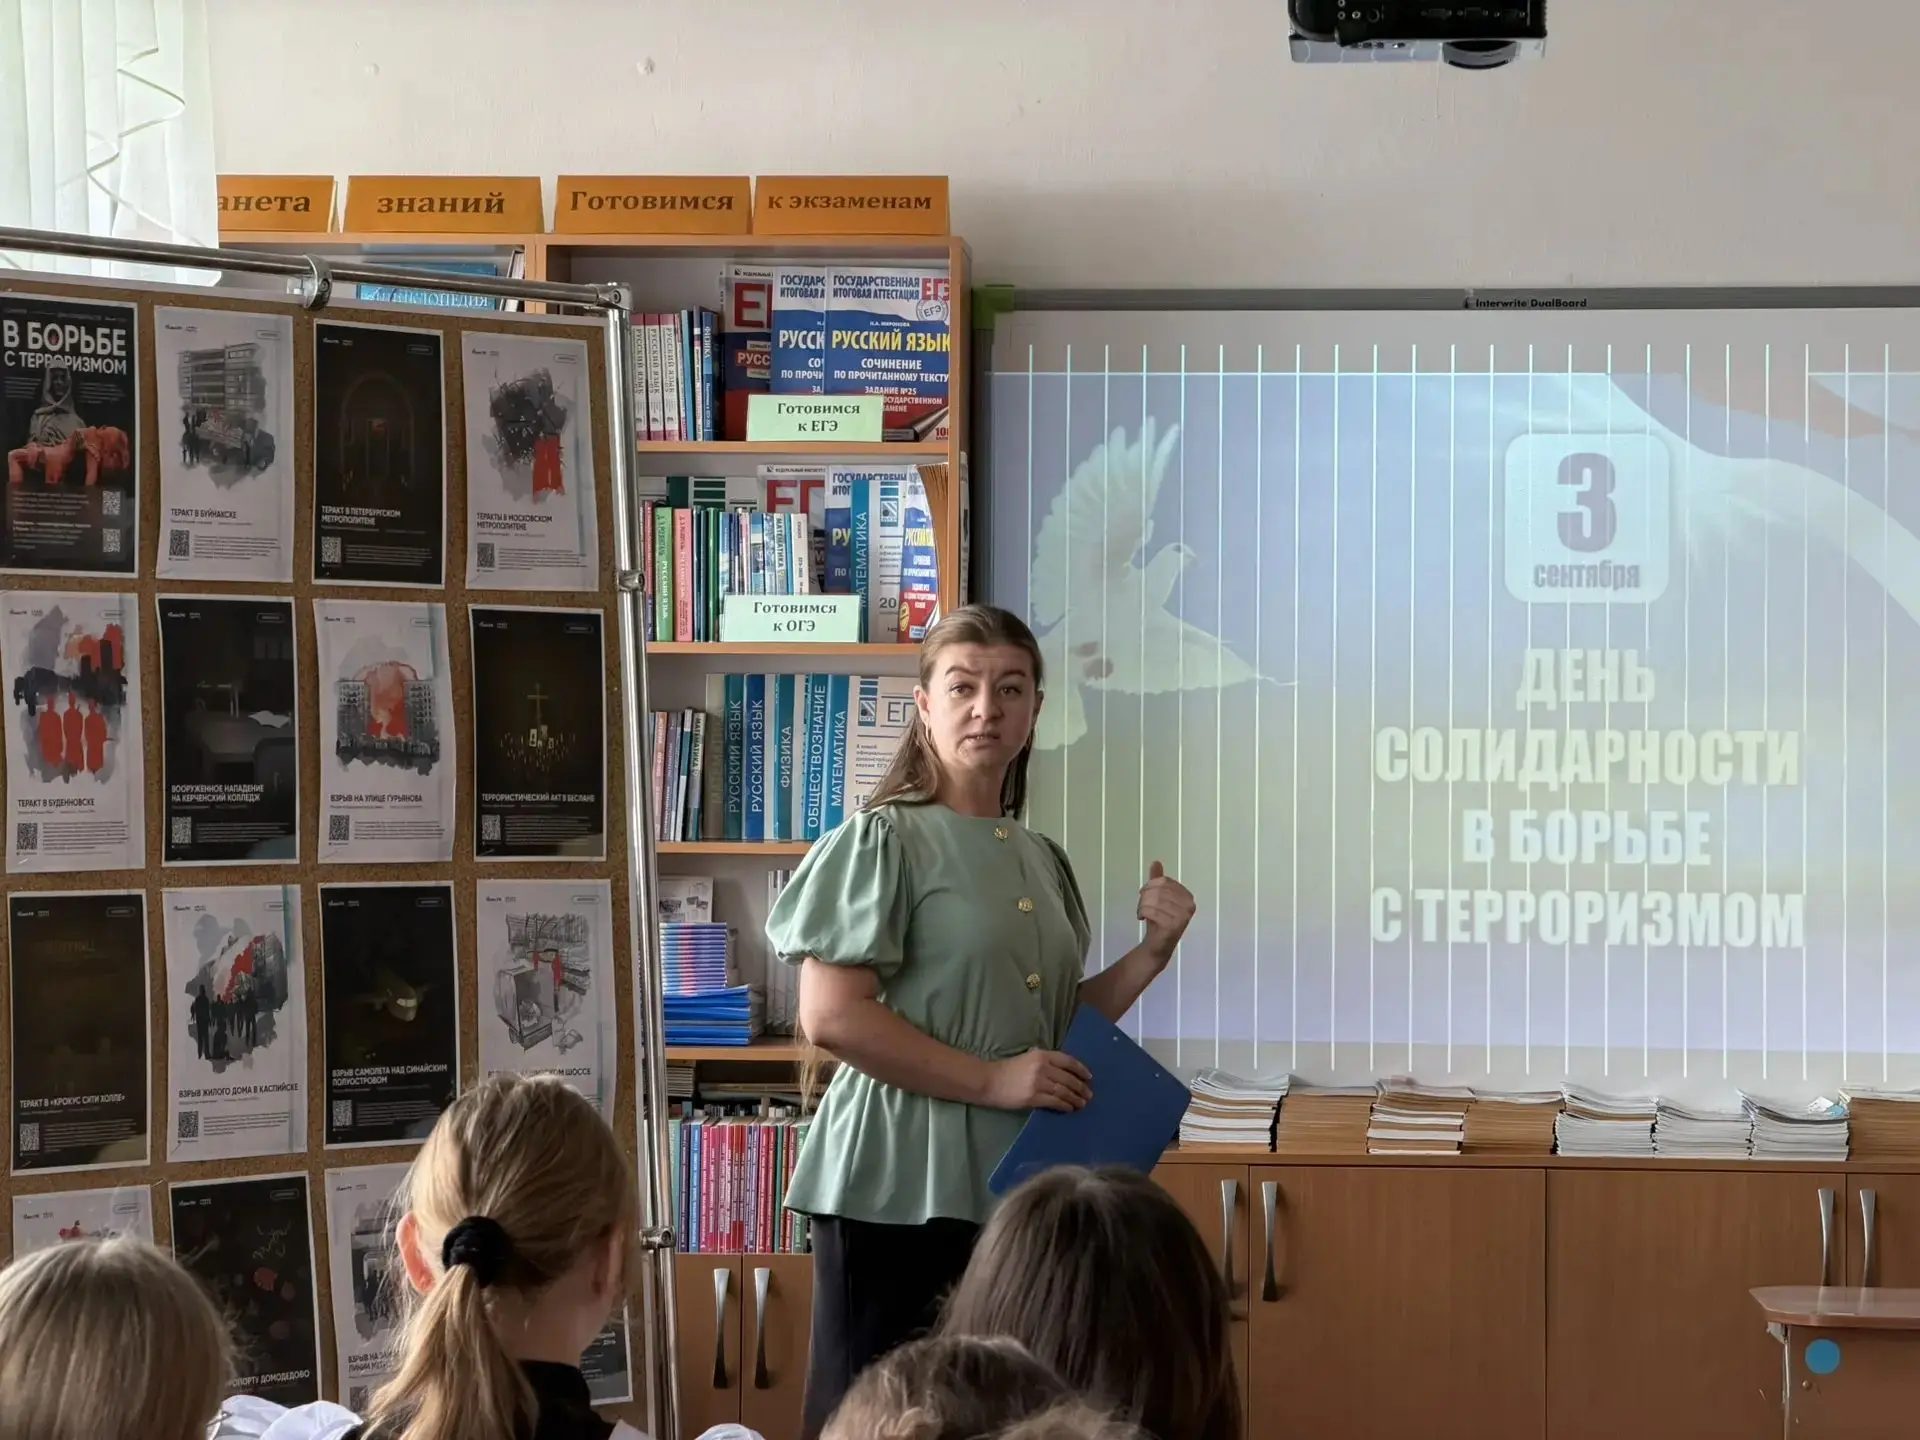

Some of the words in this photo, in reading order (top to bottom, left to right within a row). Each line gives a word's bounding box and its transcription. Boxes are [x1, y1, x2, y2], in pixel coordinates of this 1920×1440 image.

[377, 192, 505, 214] знаний
[570, 190, 733, 211] Готовимся
[768, 196, 783, 209] к
[789, 195, 932, 211] экзаменам
[833, 275, 920, 288] ГОСУДАРСТВЕННАЯ
[780, 287, 819, 299] ИТОГОВАЯ
[833, 288, 872, 299] ИТОГОВАЯ
[872, 289, 920, 301] АТТЕСТАЦИЯ
[921, 278, 950, 301] ЕГЭ
[1476, 298, 1527, 308] Interwrite
[1531, 298, 1587, 308] DualBoard
[923, 305, 942, 317] ЕГЭ
[3, 320, 20, 348] В
[27, 322, 127, 357] БОРЬБЕ
[832, 328, 902, 351] РУССКИЙ
[905, 332, 950, 352] ЯЗЫК
[4, 351, 16, 367] С
[737, 353, 771, 366] РУСС
[861, 358, 922, 370] СОЧИНЕНИЕ
[781, 370, 793, 379] ПО
[834, 370, 846, 379] ПО
[848, 371, 918, 382] ПРОЧИТАННОМУ
[920, 373, 949, 383] ТЕКСТУ
[865, 386, 898, 395] ЗАДАНИЕ
[900, 387, 917, 395] №25
[777, 403, 860, 414] Готовимся
[798, 422, 807, 432] к
[811, 421, 838, 432] ЕГЭ
[1556, 452, 1617, 553] 3
[171, 508, 194, 517] ТЕРАКТ
[195, 509, 199, 517] В
[200, 508, 237, 519] БУЙНАКСКЕ
[321, 505, 344, 515] ТЕРАКТ
[351, 507, 401, 518] ПЕТЕРБУРГСКОМ
[477, 513, 503, 521] ТЕРАКТЫ
[508, 514, 553, 523] МОСКОВСКОМ
[477, 522, 527, 531] МЕТРОПОЛИТЕНЕ
[775, 518, 785, 568] МАТЕМАТИКА
[855, 511, 867, 607] МАТЕМАТИКА
[835, 568, 846, 577] ПО
[1533, 561, 1640, 591] сентября
[754, 602, 837, 614] Готовимся
[773, 621, 782, 632] к
[786, 620, 816, 632] ОГЭ
[1516, 649, 1654, 711] ДЕНЬ
[730, 700, 741, 740] ЯЗЫК
[751, 700, 763, 740] ЯЗЫК
[780, 726, 791, 788] ФИЗИКА
[807, 685, 826, 828] ОБЩЕСТВОЗНАНИЕ
[830, 710, 846, 807] МАТЕМАТИКА
[1375, 727, 1798, 791] СОЛИДАРНОСТИ
[729, 745, 741, 813] РУССКИЙ
[750, 744, 763, 813] РУССКИЙ
[171, 784, 223, 793] ВООРУЖЕННОЕ
[224, 784, 264, 793] НАПАДЕНИЕ
[18, 799, 41, 808] ТЕРАКТ
[48, 798, 95, 808] БУДЕННОВСКЕ
[171, 794, 181, 802] НА
[182, 793, 226, 802] КЕРЧЕНСКИЙ
[227, 794, 260, 803] КОЛЛЕДЖ
[365, 795, 385, 803] УЛИЦЕ
[387, 794, 423, 802] ГУРЬЯНОВА
[482, 793, 549, 801] ТЕРРОРИСТИЧЕСКИЙ
[1463, 810, 1495, 864] В
[1509, 810, 1711, 866] БОРЬБЕ
[1371, 888, 1402, 943] С
[1415, 889, 1805, 949] ТЕРРОРИЗМОМ
[332, 1069, 353, 1077] ВЗРЫВ
[355, 1067, 390, 1077] САМОЛЕТА
[391, 1066, 404, 1075] НАД
[406, 1063, 447, 1074] СИНАЙСКИМ
[565, 1068, 591, 1076] ШОССЕ
[332, 1077, 387, 1087] ПОЛУОСТРОВОМ
[179, 1089, 201, 1098] ВЗРЫВ
[203, 1087, 231, 1097] ЖИЛОГО
[232, 1086, 251, 1096] ДОМА
[254, 1086, 258, 1094] В
[259, 1082, 298, 1093] КАСПИЙСКЕ
[20, 1099, 43, 1109] ТЕРАКТ
[82, 1096, 99, 1104] СИТИ
[348, 1354, 369, 1363] ВЗРЫВ
[370, 1352, 378, 1360] НА
[261, 1370, 310, 1384] ДОМОДЕДОВО
